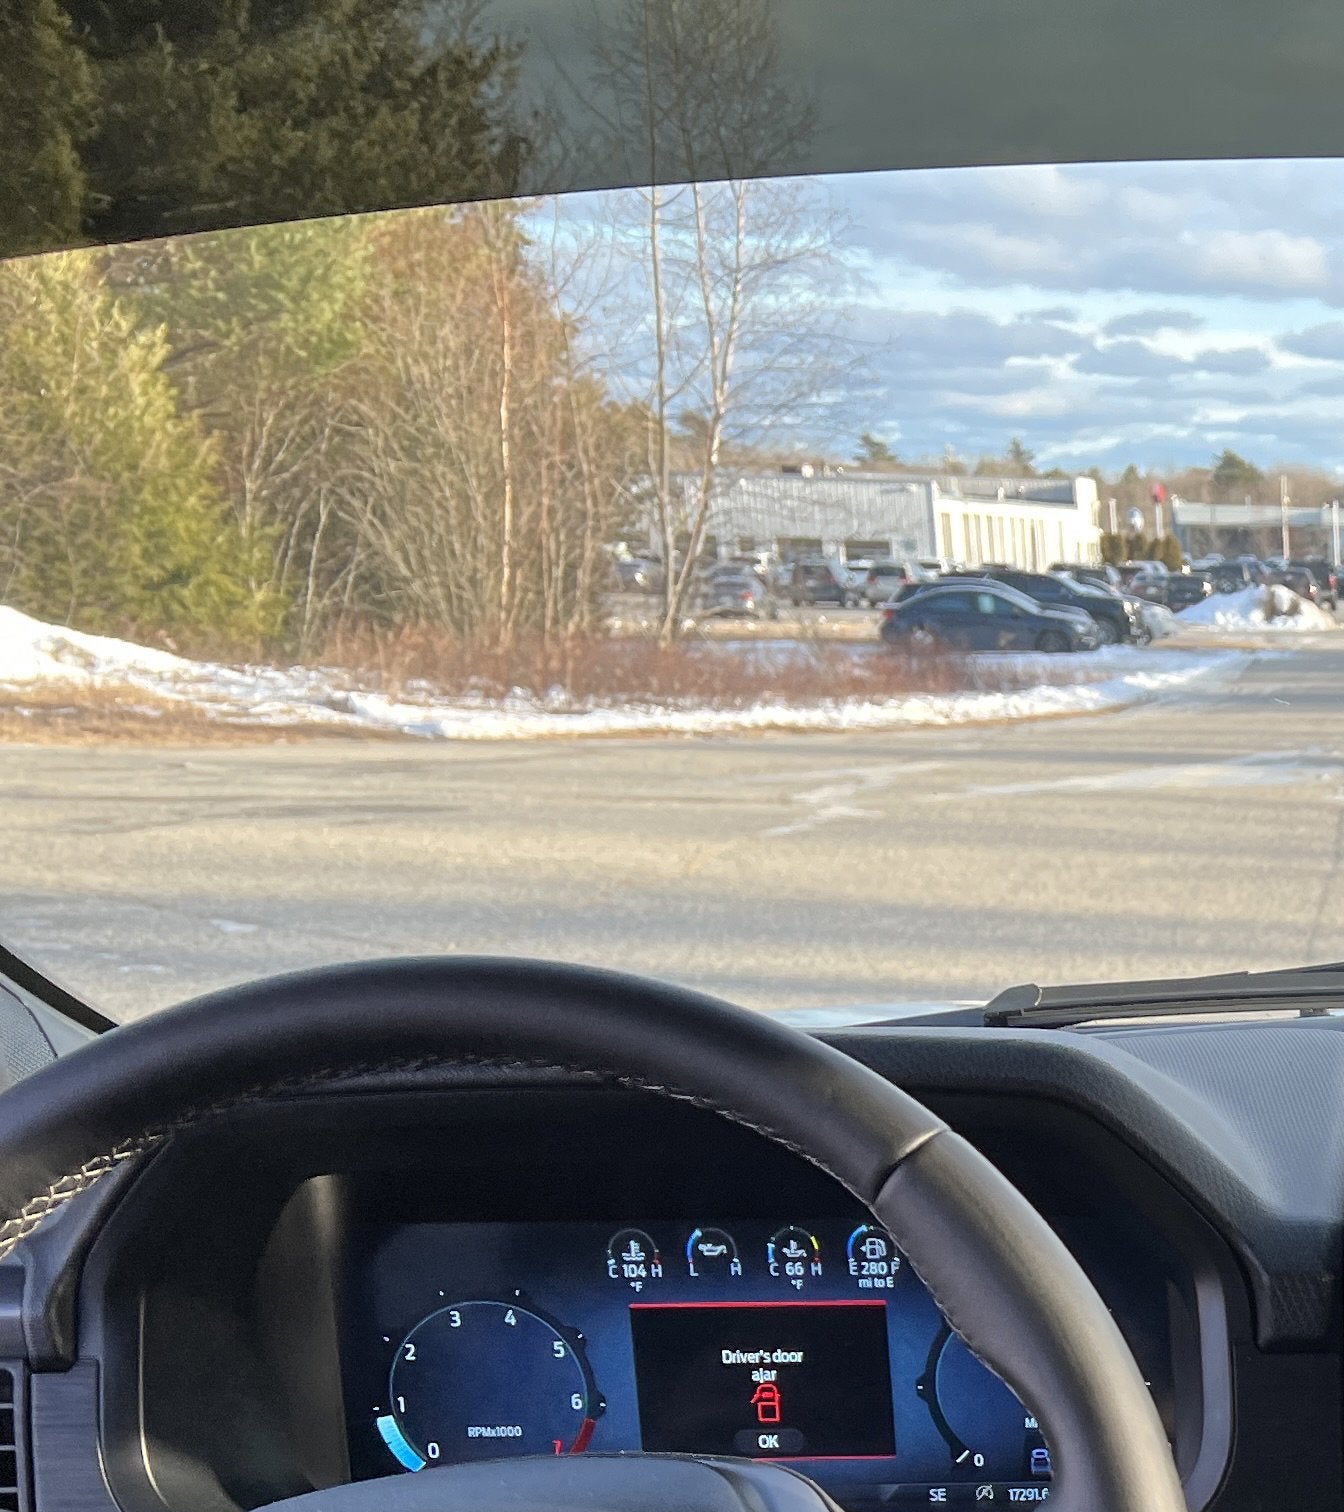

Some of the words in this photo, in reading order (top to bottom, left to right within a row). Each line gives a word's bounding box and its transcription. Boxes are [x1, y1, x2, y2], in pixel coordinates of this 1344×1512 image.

[608, 1265, 618, 1278] C
[621, 1264, 647, 1277] 104
[652, 1264, 663, 1278] H
[690, 1264, 700, 1277] L
[730, 1263, 742, 1276] H
[769, 1264, 779, 1277] C
[785, 1263, 804, 1275] 66
[811, 1263, 822, 1276] H
[849, 1262, 858, 1276] E
[860, 1262, 887, 1275] 280
[858, 1277, 872, 1288] mi
[873, 1278, 886, 1288] to
[886, 1277, 894, 1288] E
[449, 1310, 461, 1328] 3
[504, 1309, 517, 1326] 4
[404, 1343, 417, 1361] 2
[553, 1341, 565, 1358] 5
[721, 1349, 771, 1364] Driver's
[771, 1348, 804, 1363] door
[751, 1367, 778, 1383] ajar
[397, 1396, 405, 1413] 1
[570, 1393, 583, 1410] 6
[467, 1425, 523, 1438] RPMx1000
[758, 1434, 780, 1449] OK
[427, 1442, 440, 1459] 0
[973, 1453, 985, 1467] 0
[929, 1487, 947, 1502] SE
